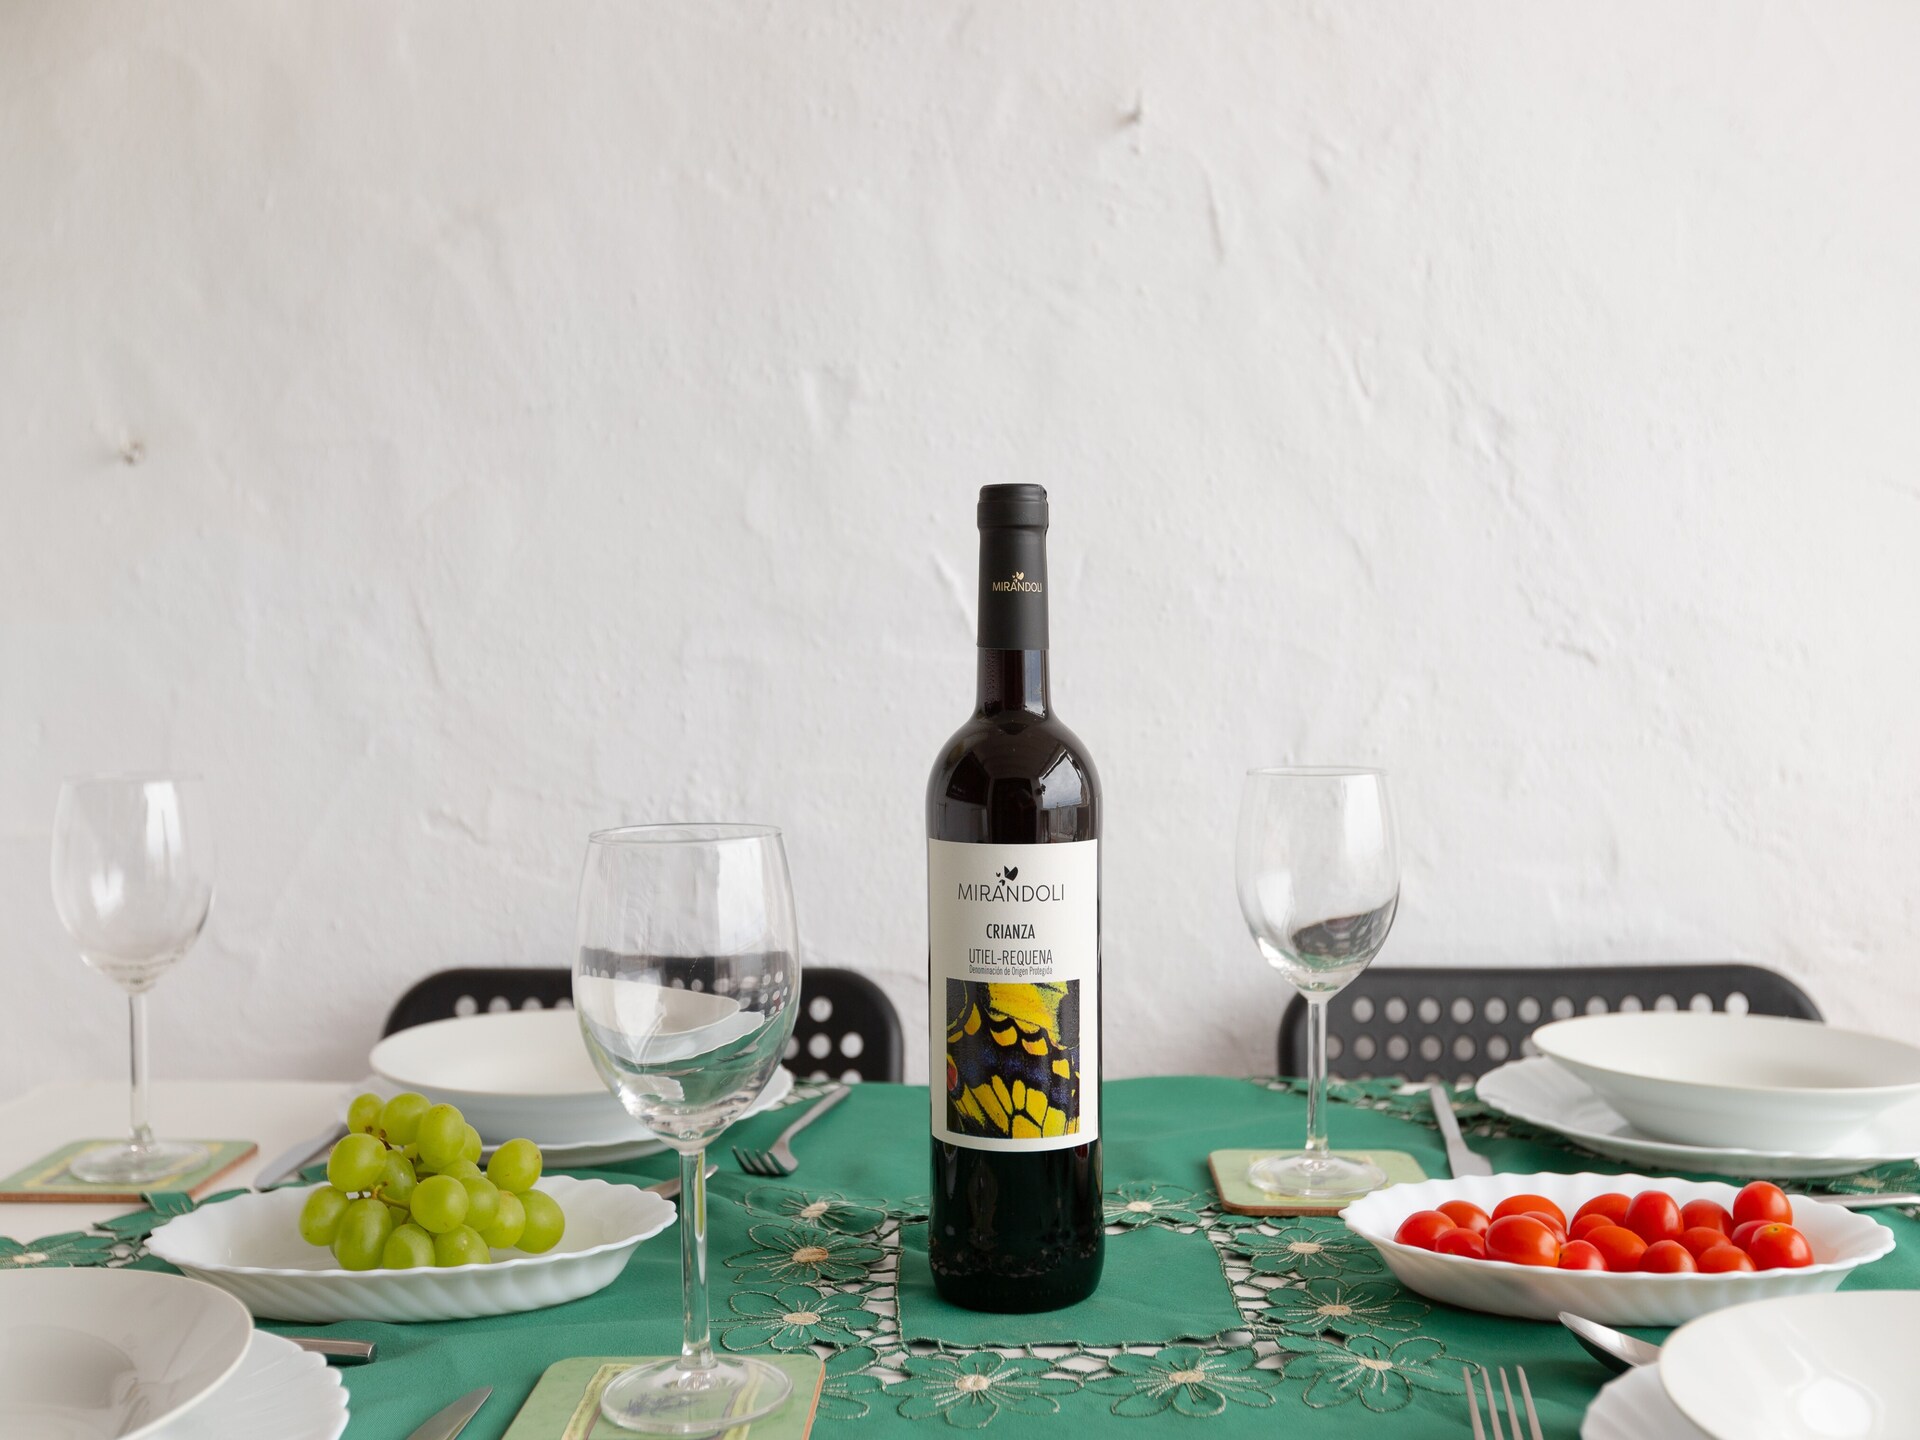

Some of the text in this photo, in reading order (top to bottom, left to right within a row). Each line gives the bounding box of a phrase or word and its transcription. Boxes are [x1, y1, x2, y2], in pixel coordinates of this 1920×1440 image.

[992, 582, 1042, 592] MIRANDOLI
[958, 883, 1064, 902] MIRANDOLI
[986, 924, 1035, 939] CRIANZA
[969, 948, 1053, 966] UTIEL-REQUENA
[969, 965, 1052, 977] Denominación de Origen Protegida
